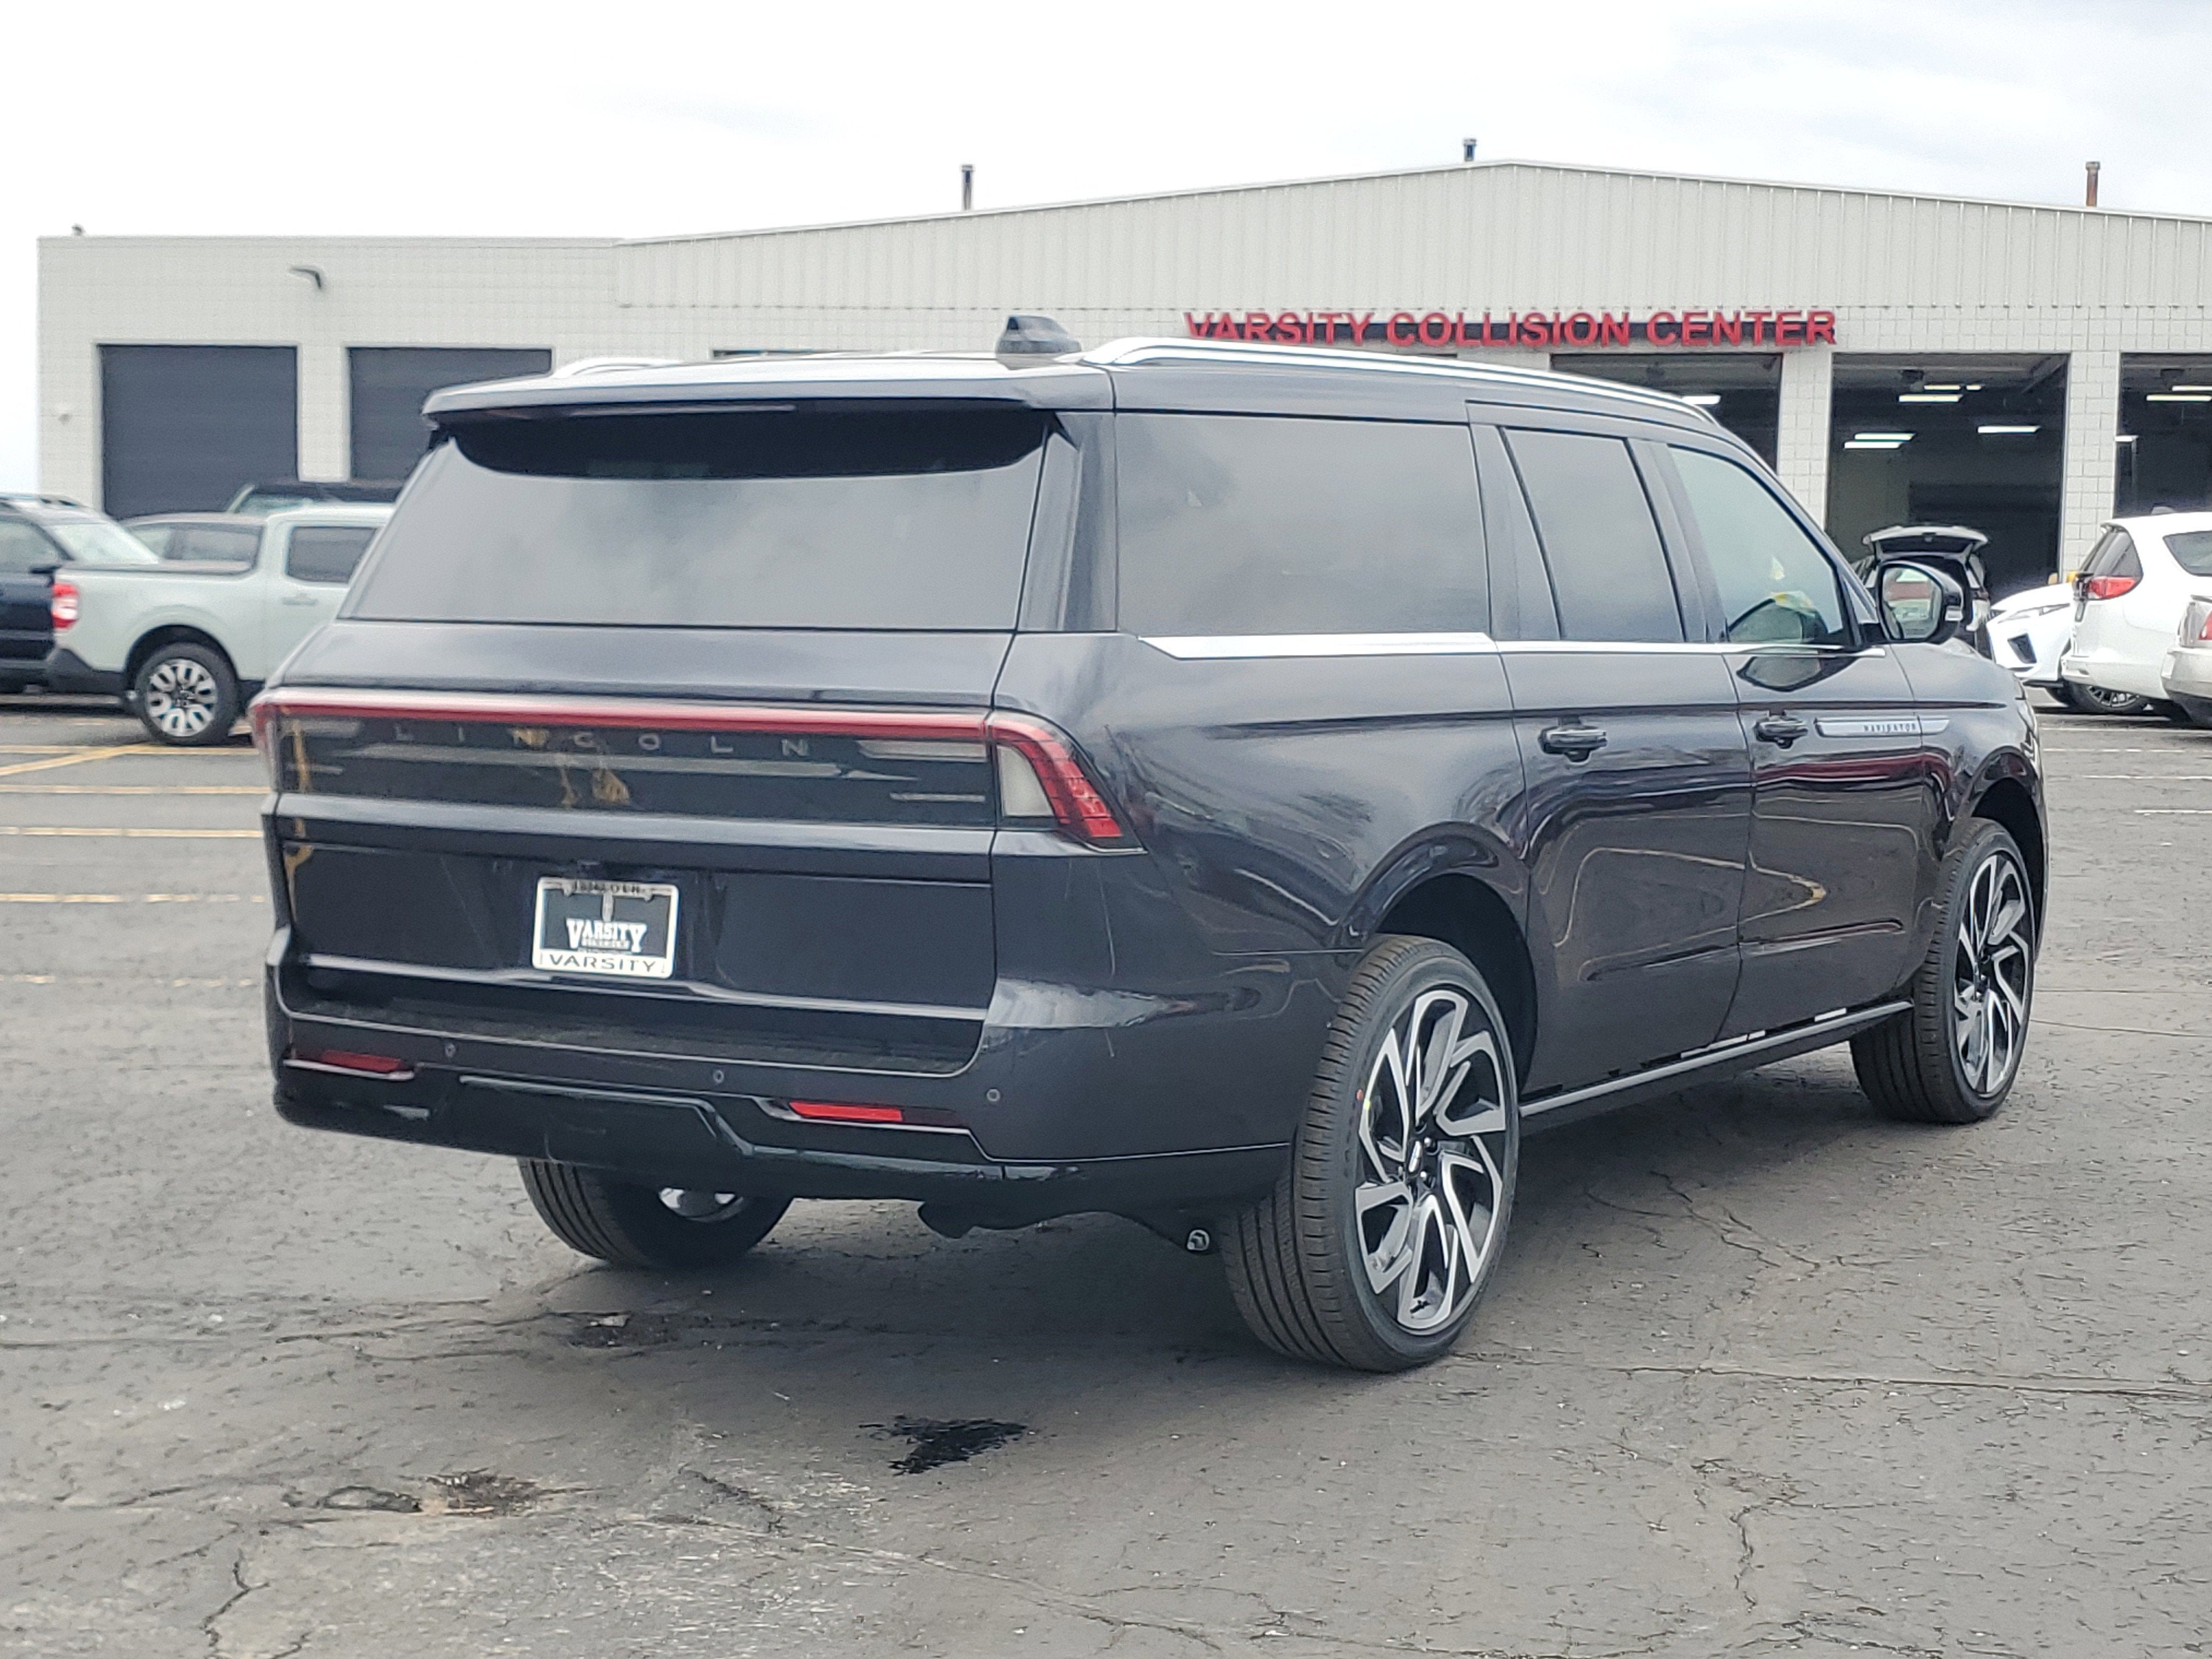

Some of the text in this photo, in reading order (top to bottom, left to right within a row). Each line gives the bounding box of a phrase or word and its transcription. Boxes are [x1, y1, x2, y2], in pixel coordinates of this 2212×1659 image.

[1184, 311, 1837, 347] VARSITY COLLISION CENTER
[393, 723, 809, 757] LINCOLN
[566, 918, 647, 953] VARSITY
[550, 954, 656, 973] VARSITY
